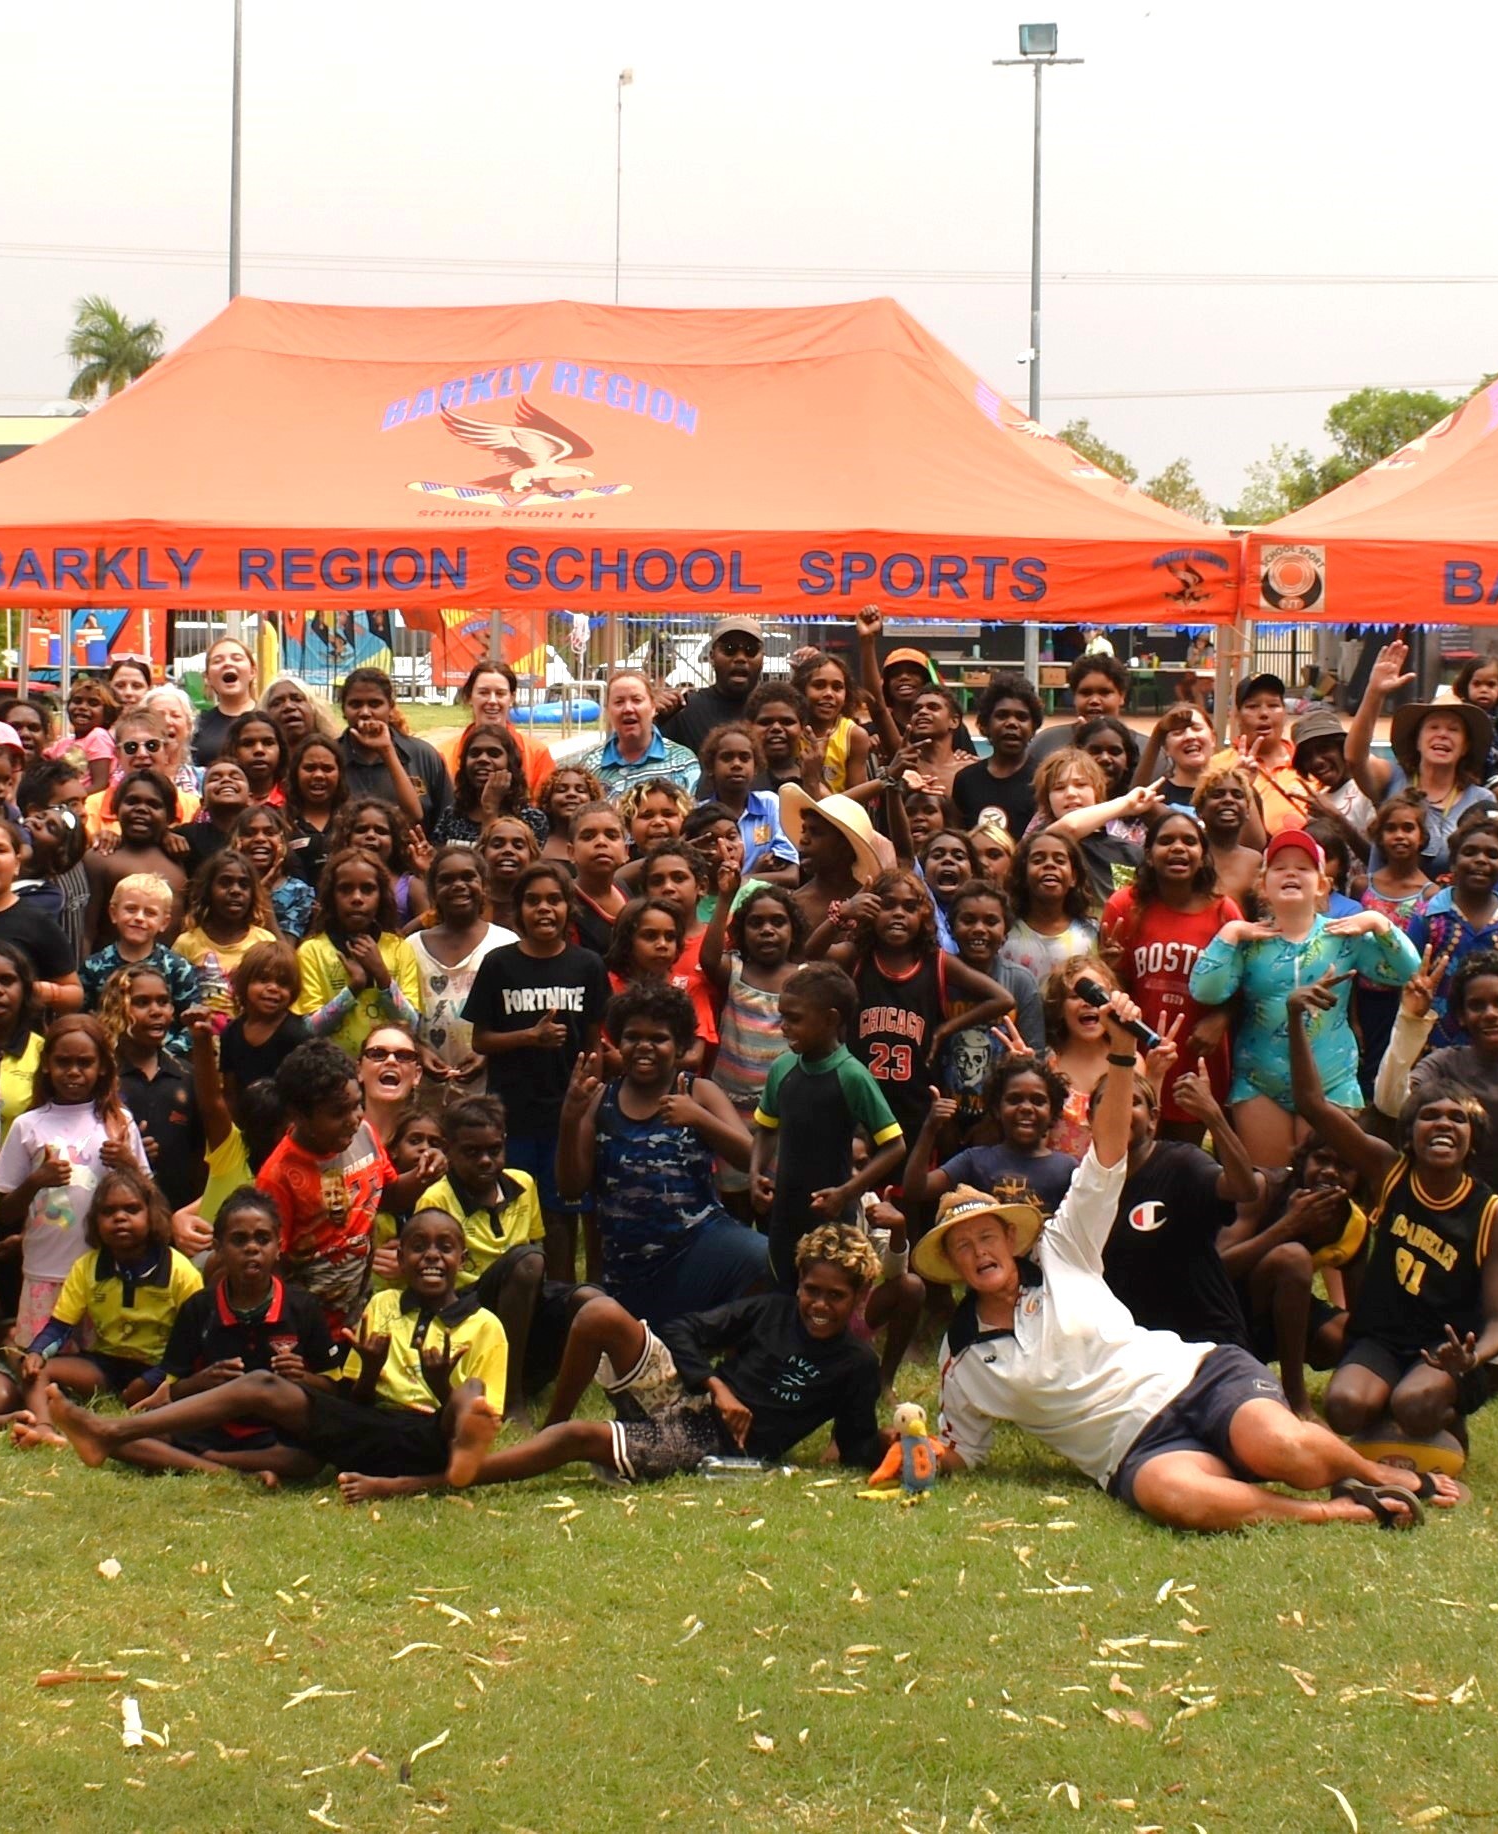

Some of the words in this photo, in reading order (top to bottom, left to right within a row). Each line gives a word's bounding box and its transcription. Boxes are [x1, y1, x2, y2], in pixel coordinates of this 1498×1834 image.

[380, 360, 545, 433] BARKLY
[551, 360, 699, 436] REGION
[417, 509, 492, 518] SCHOOL
[501, 510, 564, 519] SPORT
[572, 511, 598, 519] NT
[239, 547, 467, 591] REGION
[505, 546, 762, 596] SCHOOL
[799, 551, 1048, 602] SPORTS
[1263, 544, 1297, 568] SCHOOL
[1299, 546, 1326, 569] SPORT
[1281, 599, 1302, 609] NT
[502, 986, 586, 1015] FORTNITE
[859, 1006, 926, 1047] CHICAGO
[868, 1042, 913, 1081] 23
[1407, 1222, 1458, 1272] ANGELES
[911, 1443, 933, 1480] B
